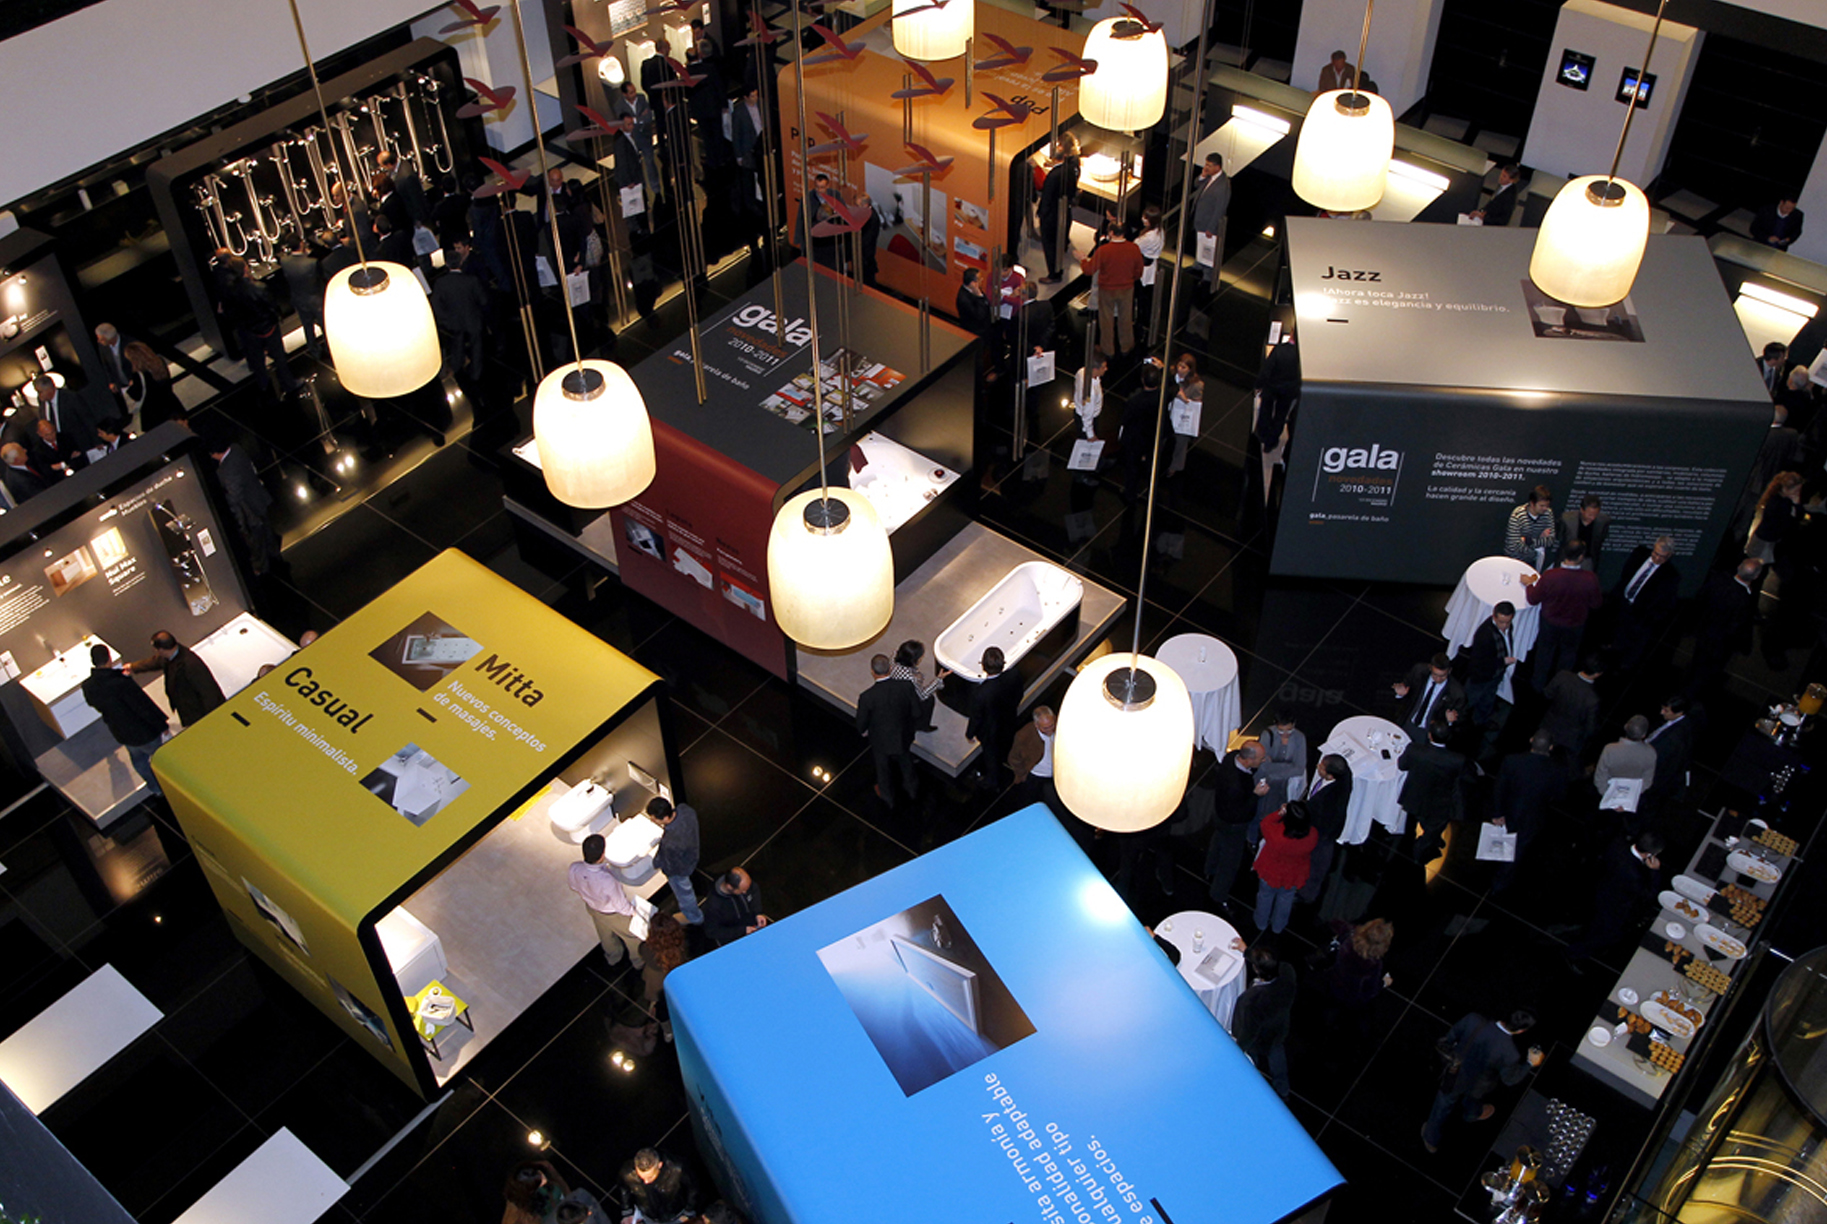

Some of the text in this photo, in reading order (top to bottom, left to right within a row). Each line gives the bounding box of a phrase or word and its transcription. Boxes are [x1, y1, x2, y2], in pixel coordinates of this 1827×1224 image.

[1011, 95, 1050, 114] Pop
[791, 127, 816, 148] Pp
[1321, 266, 1382, 282] Jazz
[1367, 290, 1394, 298] toca
[1372, 298, 1433, 310] elegancia
[1434, 302, 1443, 310] y
[732, 304, 813, 347] gala
[726, 326, 788, 358] novedades
[728, 337, 780, 366] 2010-2011
[1322, 443, 1400, 473] gala
[1435, 452, 1562, 466] Descubre todas las novedades
[1445, 461, 1490, 470] Cerámicas
[1492, 463, 1512, 472] Gala
[1328, 475, 1393, 485] novedades
[1431, 469, 1476, 478] showroom
[1340, 484, 1392, 495] 2010-2011
[1439, 485, 1467, 493] calidad
[1450, 493, 1478, 501] grande
[474, 653, 544, 707] Mitta
[285, 667, 374, 734] Casual
[433, 692, 497, 741] de masajes.
[447, 680, 547, 752] Nuevos conceptos
[253, 691, 358, 775] Espíritu minimalista.
[982, 1111, 1000, 1123] y
[984, 1072, 1042, 1150] adaptable
[1045, 1122, 1072, 1155] tipo
[991, 1123, 1042, 1194] armonía
[1087, 1135, 1143, 1213] espacios.
